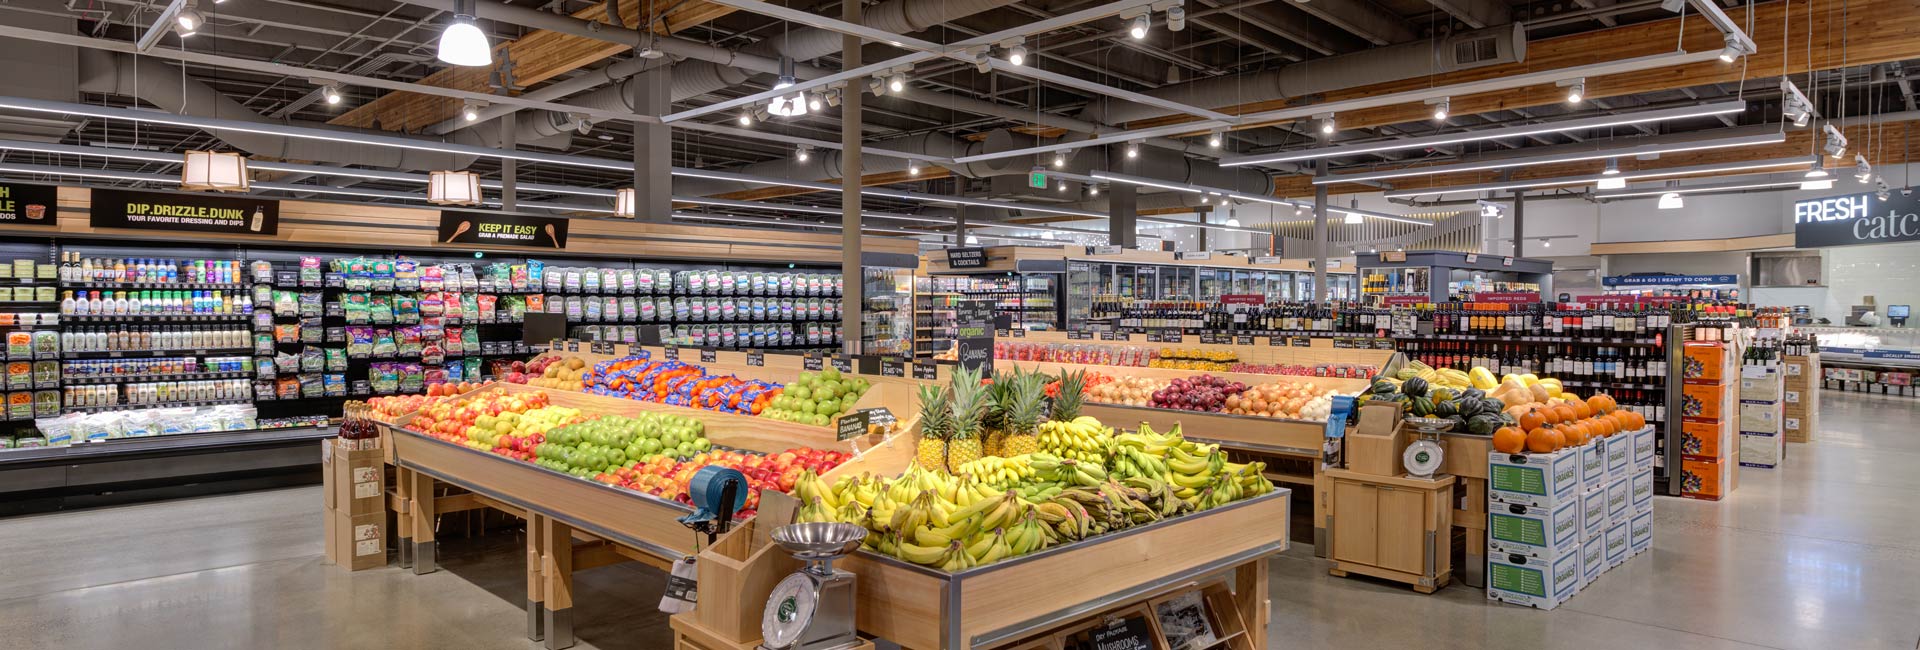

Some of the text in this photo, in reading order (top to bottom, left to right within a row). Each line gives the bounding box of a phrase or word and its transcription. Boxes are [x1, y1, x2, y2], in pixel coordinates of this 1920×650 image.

[127, 202, 244, 220] DIP.DRIZZLE.DUNK
[1795, 195, 1868, 224] FRESH
[127, 215, 146, 223] YOUR
[147, 216, 179, 224] FAVORITE
[180, 217, 213, 226] DRESSING
[479, 223, 537, 235] KEEP IT EASY
[959, 327, 985, 339] organic
[839, 421, 863, 434] BANANAS
[1555, 470, 1574, 485] ORGANICS
[1555, 521, 1574, 535] ORGANICS
[1555, 567, 1575, 585] ORGANICS
[1096, 632, 1106, 642] DRY
[1097, 635, 1139, 650] MUSHROOMS
